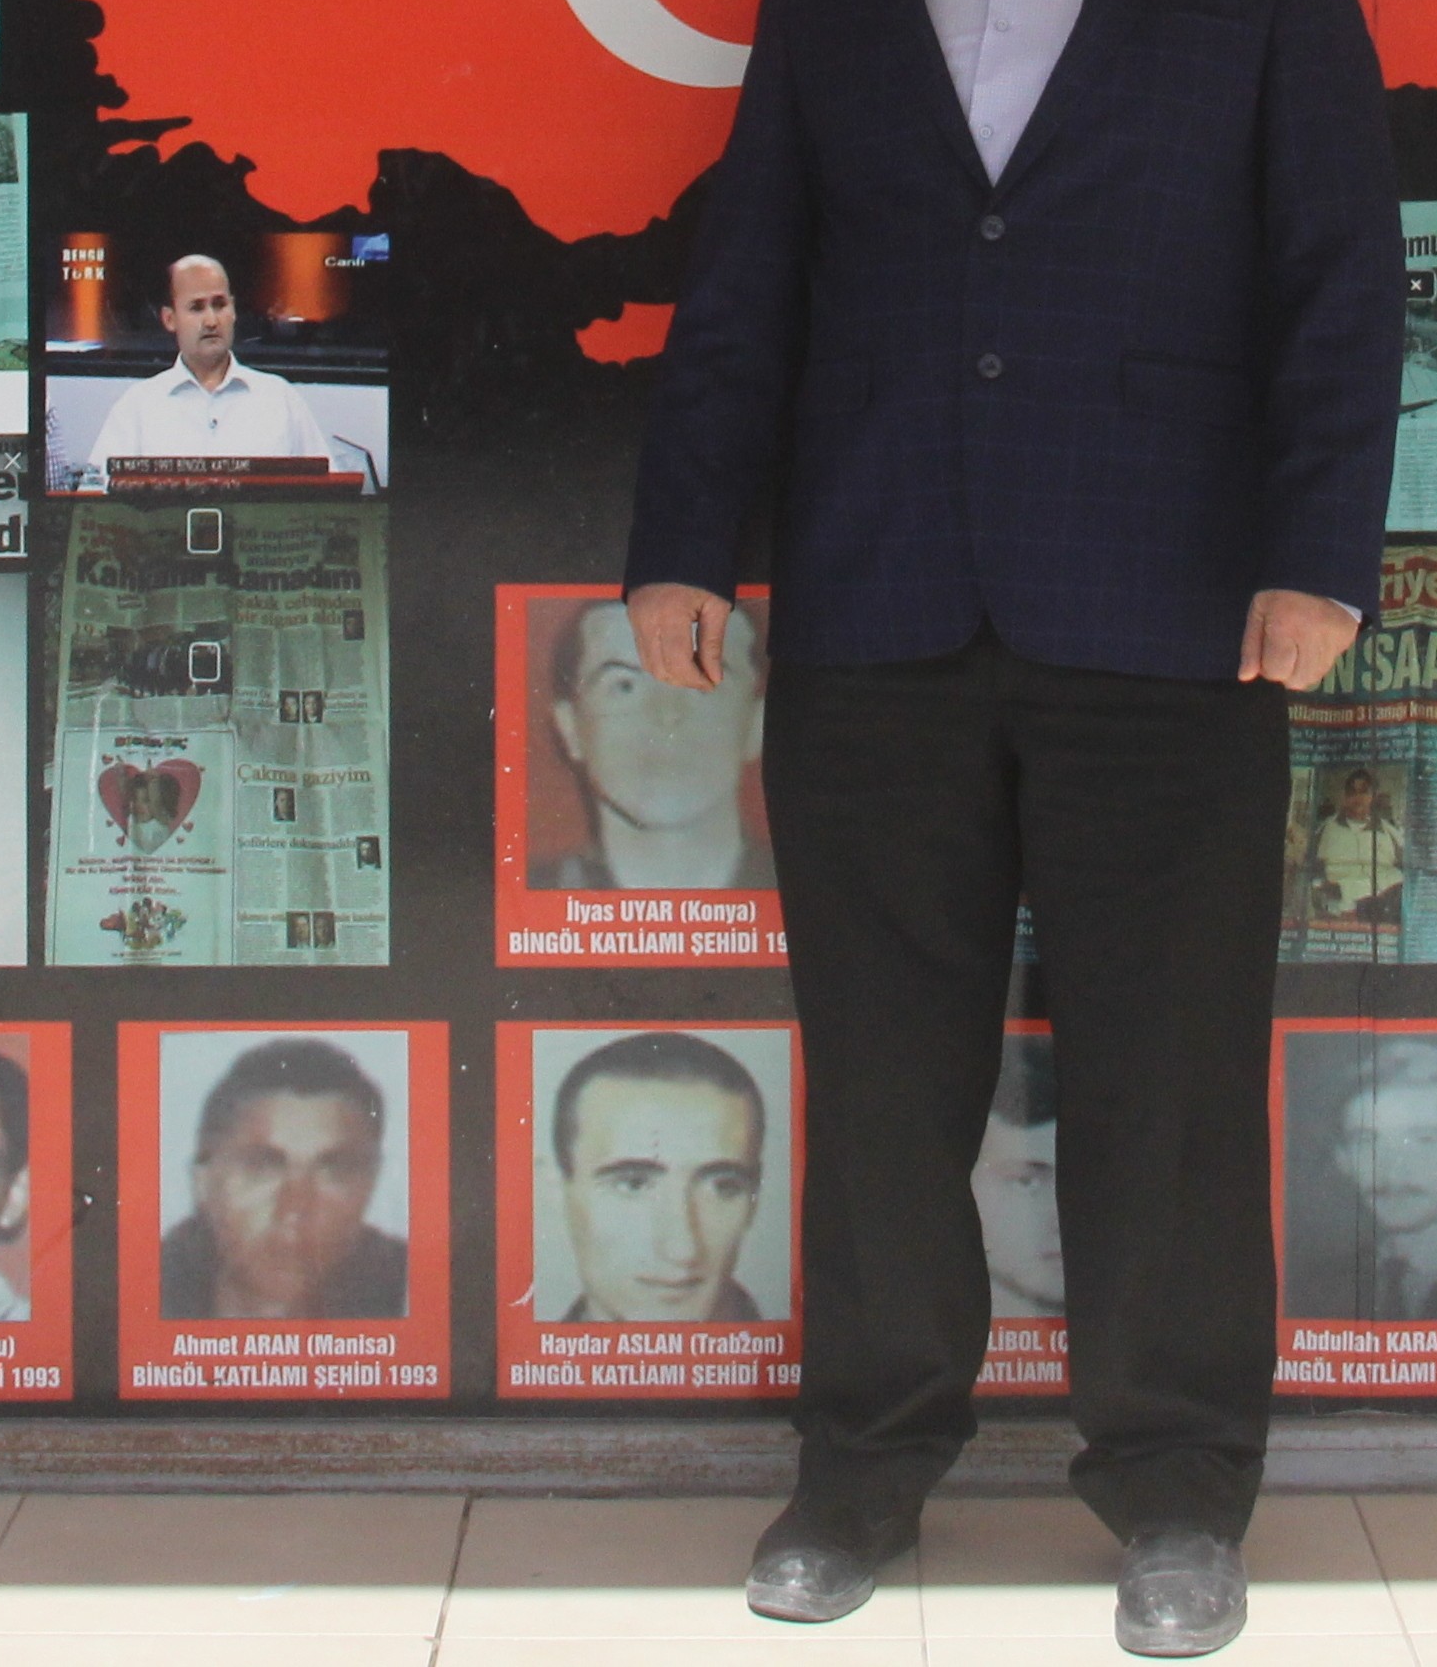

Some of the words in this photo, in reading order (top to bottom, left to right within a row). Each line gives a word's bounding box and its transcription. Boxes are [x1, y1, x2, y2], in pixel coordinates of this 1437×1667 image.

[566, 895, 616, 925] İlyas
[619, 899, 676, 923] UYAR
[679, 899, 757, 925] (Konya)
[172, 1334, 239, 1357] Ahmet
[243, 1333, 302, 1356] ARAN
[306, 1333, 397, 1358] (Manisa)
[541, 1334, 612, 1357] Haydar
[617, 1333, 684, 1355] ASLAN
[690, 1330, 784, 1355] (Trabzon)
[1292, 1328, 1382, 1353] Abdullah
